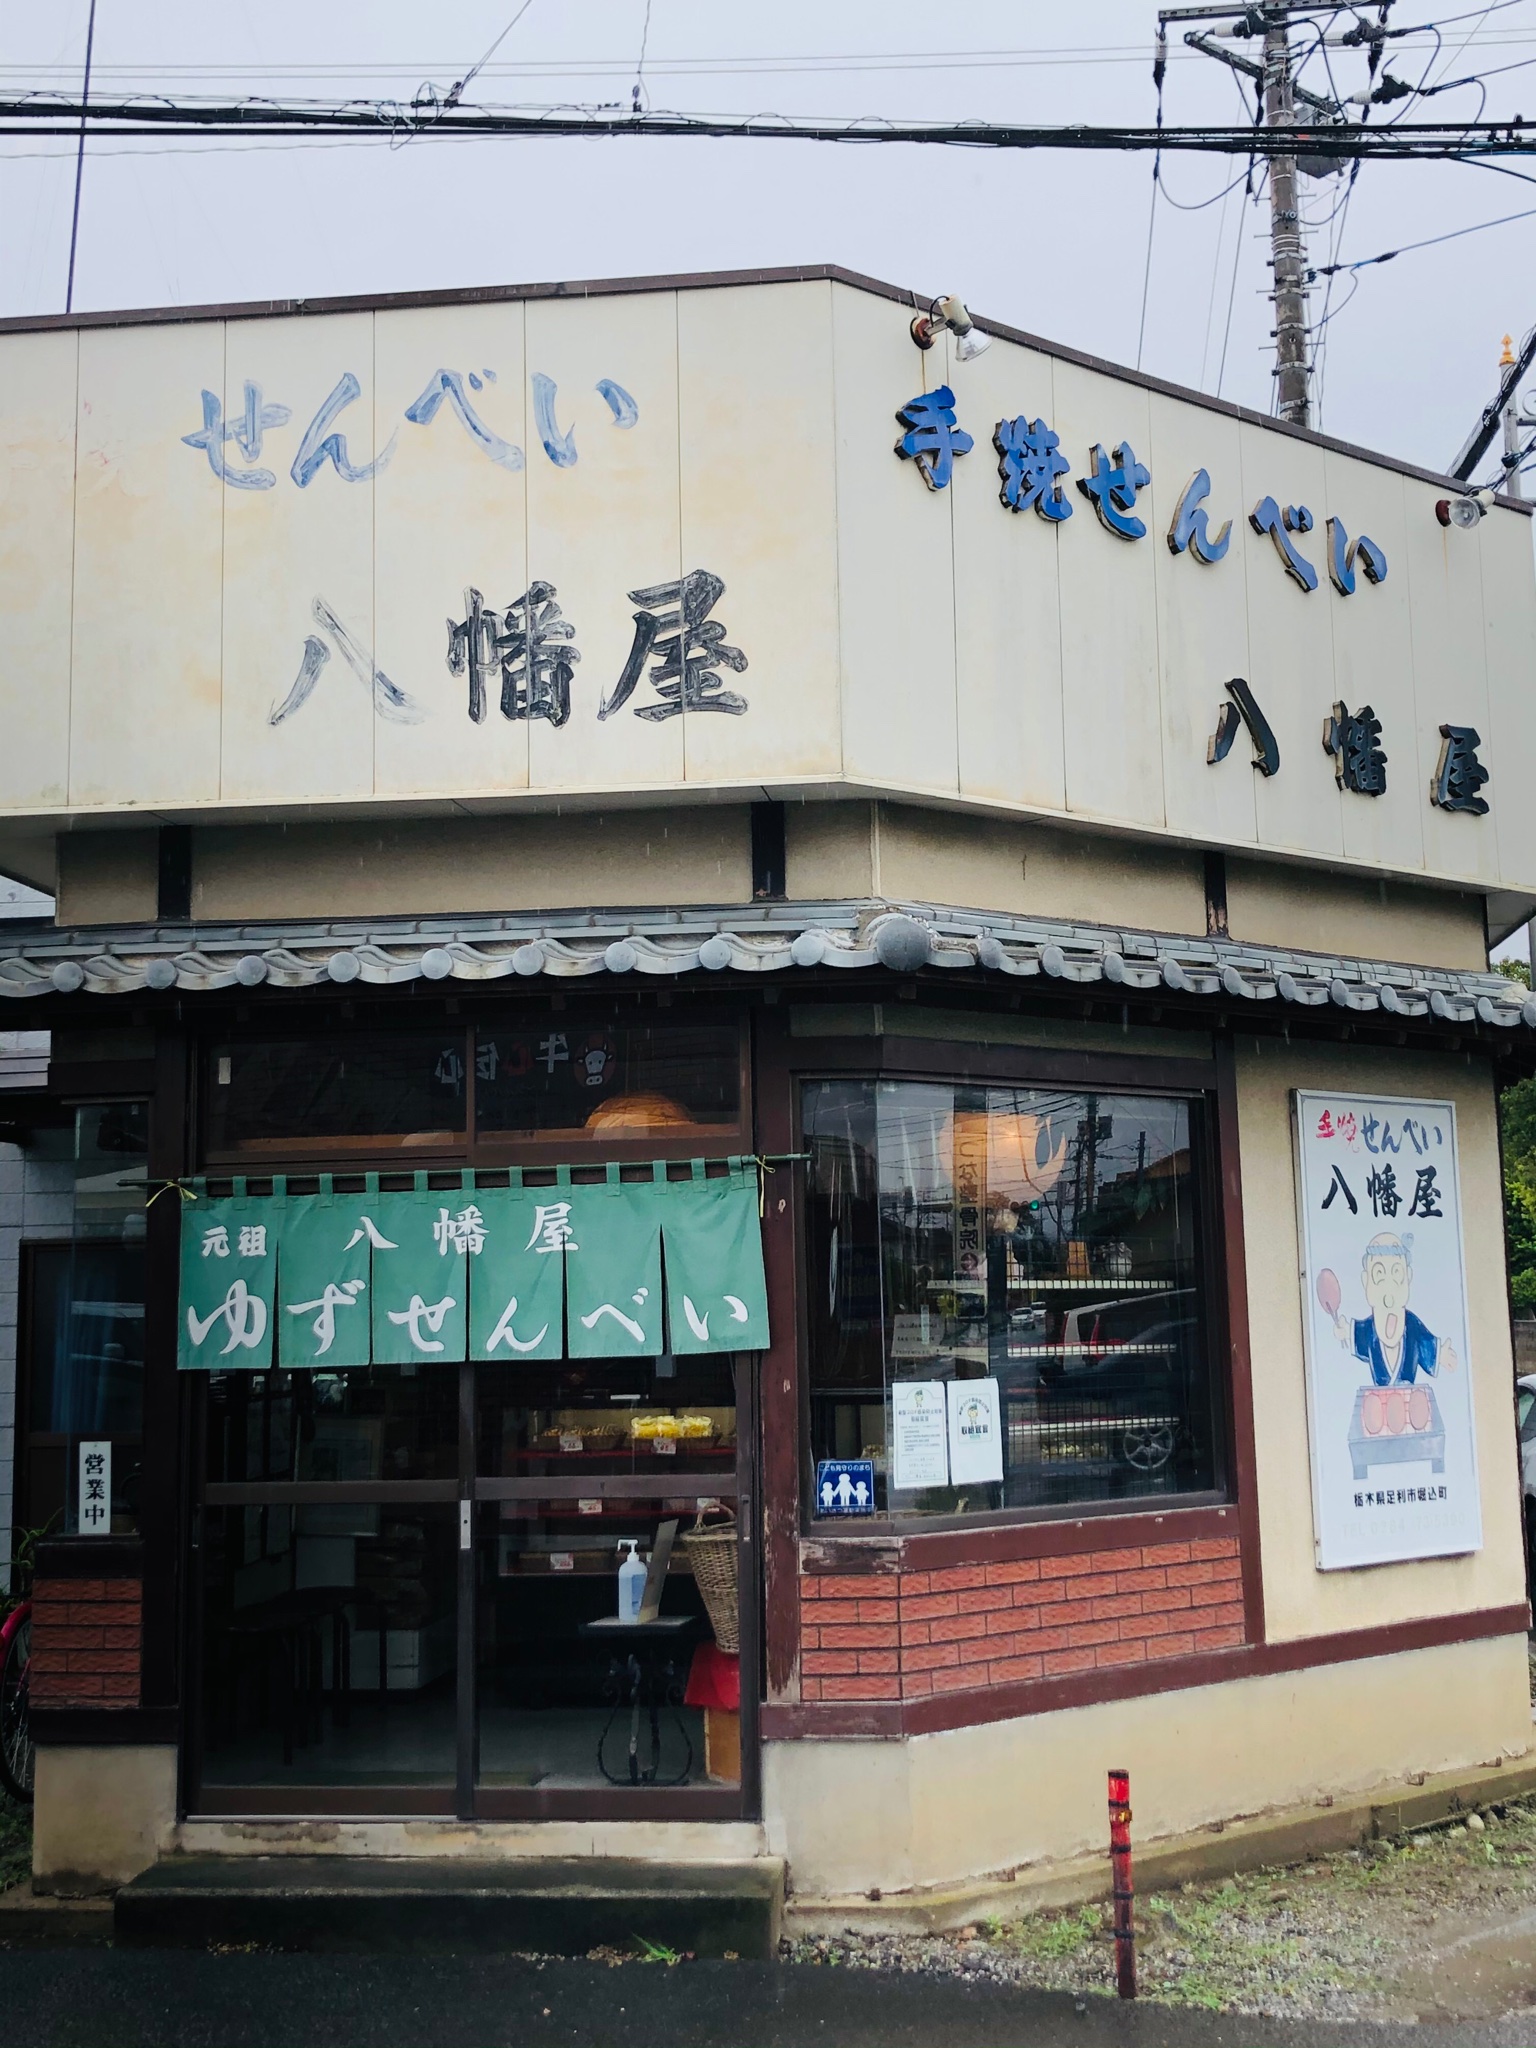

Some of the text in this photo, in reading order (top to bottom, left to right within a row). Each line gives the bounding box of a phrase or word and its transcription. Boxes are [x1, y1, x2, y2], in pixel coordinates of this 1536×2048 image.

[181, 368, 640, 491] せんべい
[894, 384, 1388, 597] 手焼せんべい
[267, 568, 749, 730] 八幡屋
[1206, 677, 1490, 815] 八幡屋
[201, 1201, 579, 1258] 元祖 八幡屋
[1321, 1162, 1443, 1218] 八幡屋
[187, 1278, 750, 1357] ゆずせんべい
[85, 1453, 105, 1526] 営業中
[1353, 1486, 1447, 1507] 栃木県足利市堀込町
